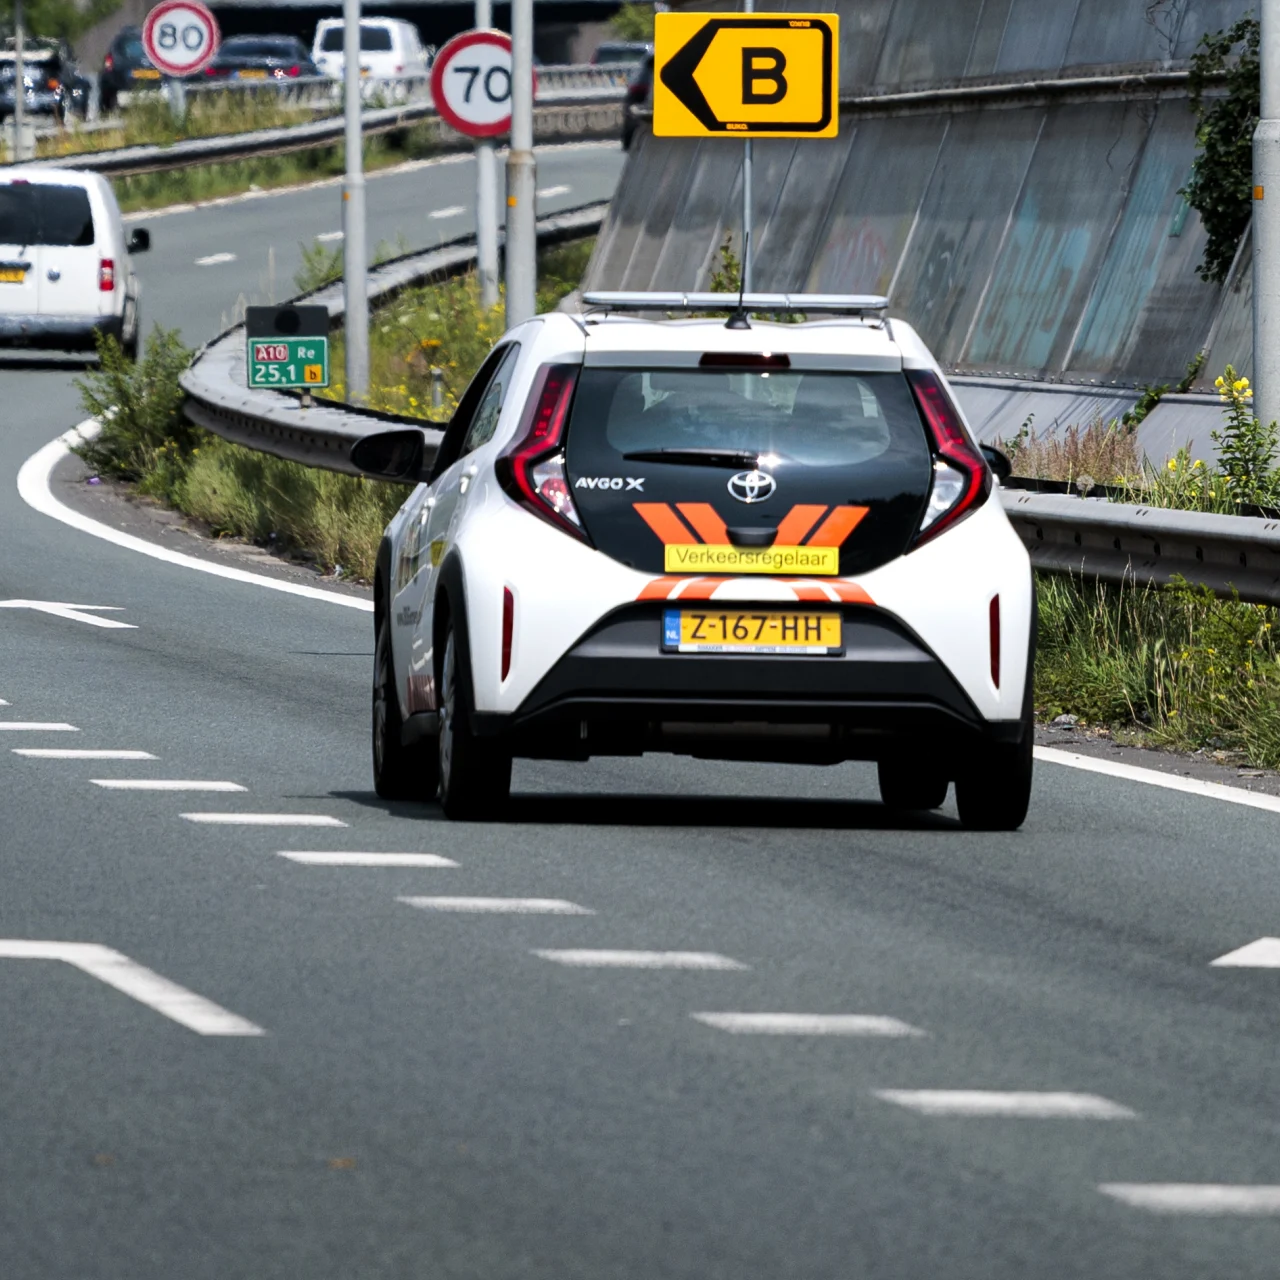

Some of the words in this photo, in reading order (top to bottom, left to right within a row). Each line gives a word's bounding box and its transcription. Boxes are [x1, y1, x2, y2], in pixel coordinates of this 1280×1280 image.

[158, 23, 203, 50] 80
[453, 66, 512, 103] 70
[742, 47, 788, 104] B
[257, 345, 287, 360] A10
[297, 346, 315, 359] Re
[255, 364, 296, 384] 25,1
[309, 368, 317, 380] b
[625, 476, 646, 492] X
[676, 548, 828, 569] Verkeersregelaar
[691, 615, 821, 641] Z-167-HH
